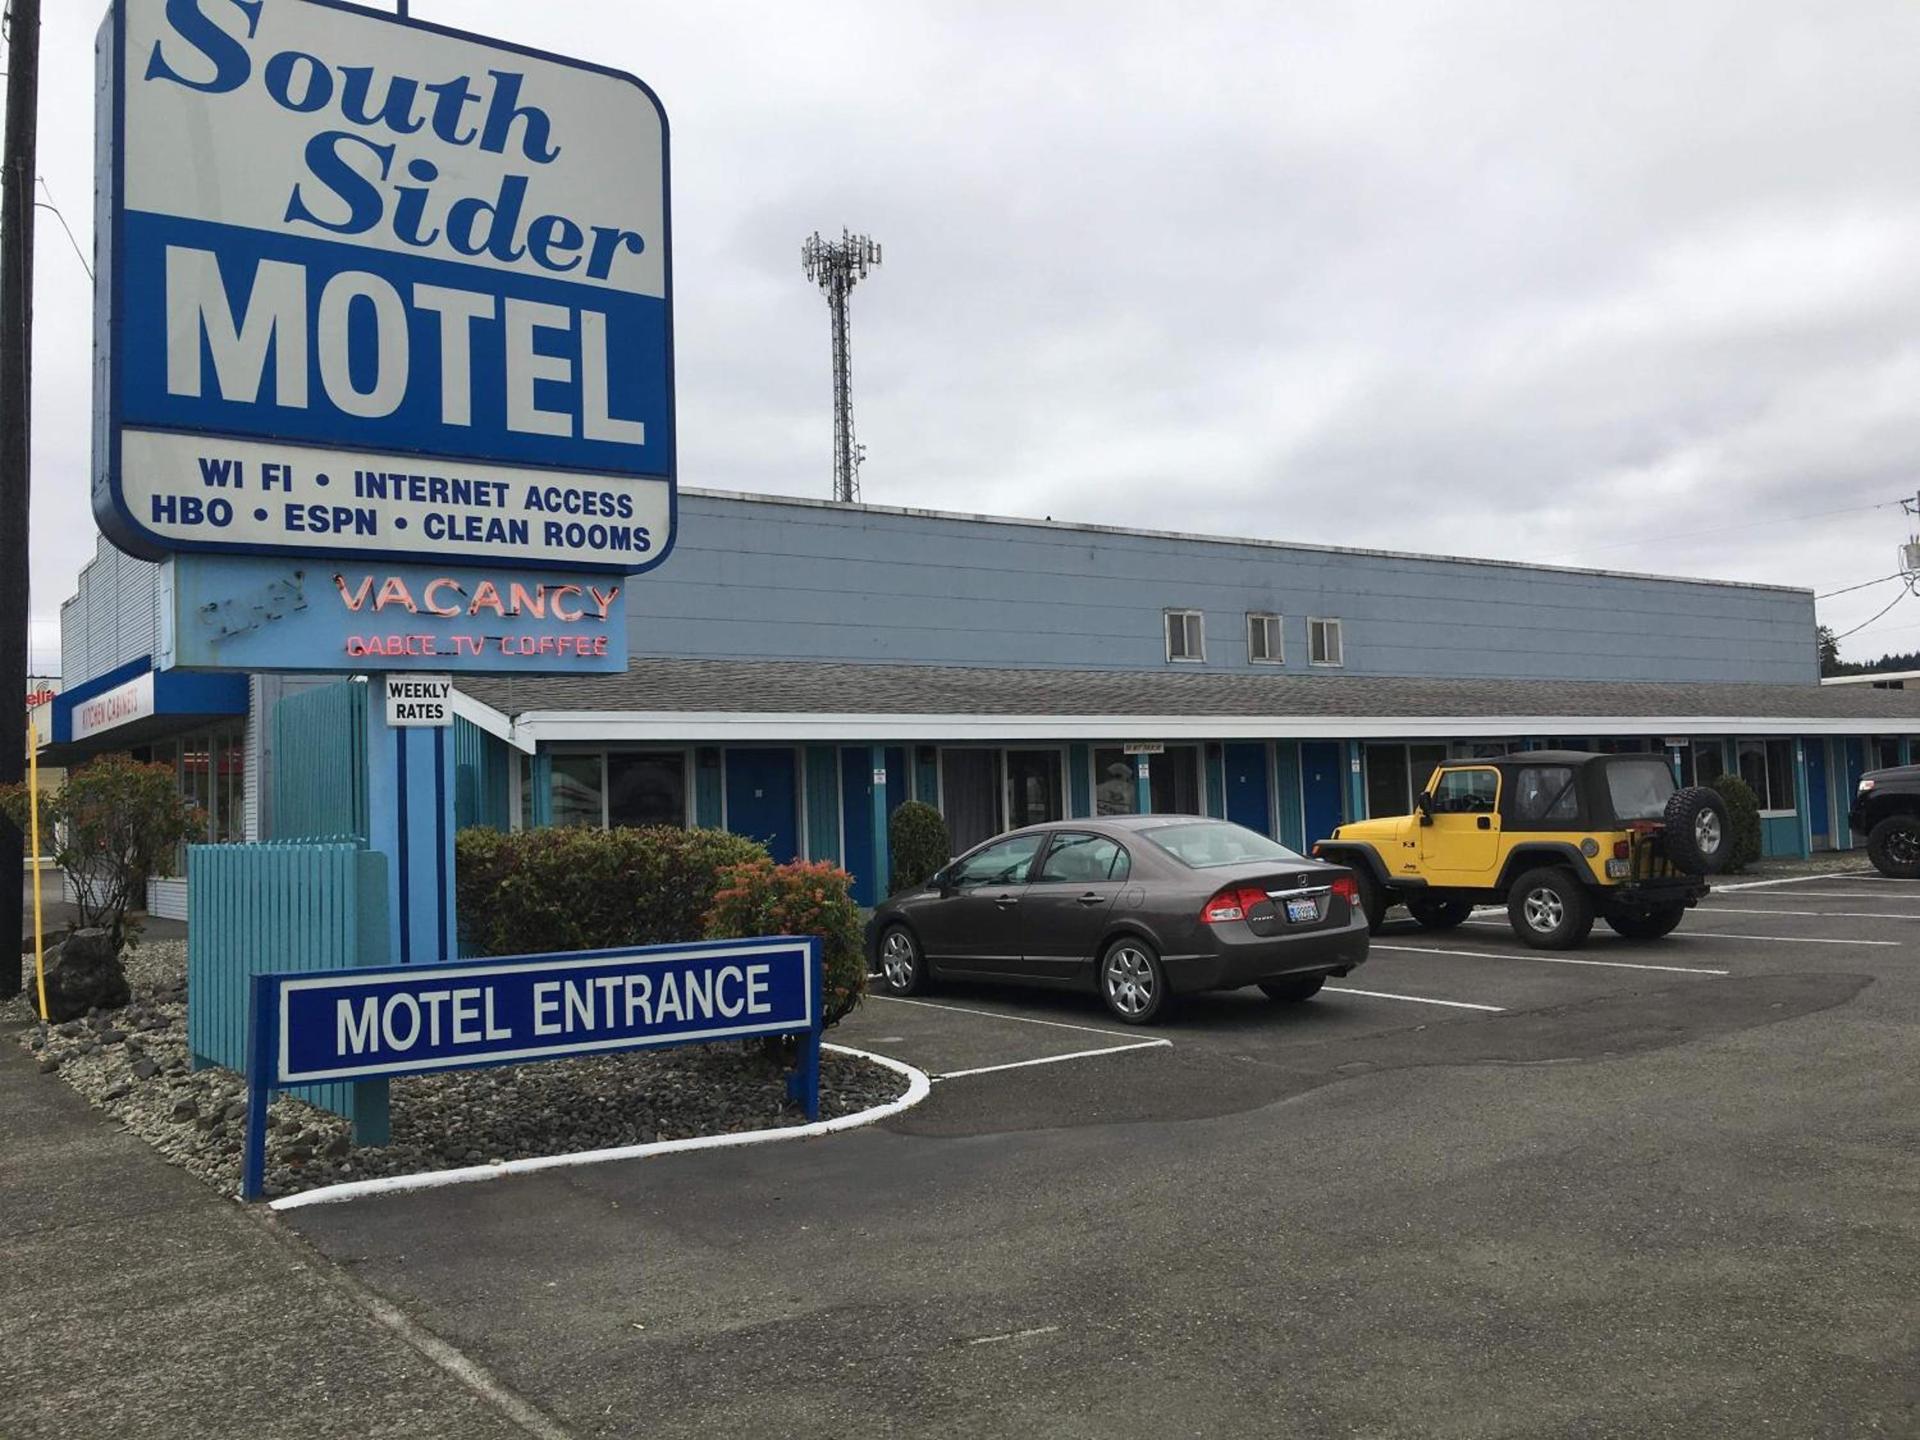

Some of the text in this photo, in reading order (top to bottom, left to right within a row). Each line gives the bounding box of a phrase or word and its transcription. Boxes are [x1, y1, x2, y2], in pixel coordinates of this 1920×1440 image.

[144, 0, 561, 164] South
[284, 130, 645, 281] Sider
[165, 244, 645, 445] MOTEL
[198, 457, 633, 519] WI FI INTERNET ACCESS
[151, 494, 650, 552] HBO ESPN CLEAN ROOMS
[333, 574, 619, 622] VACANCY
[450, 635, 485, 657] TV
[501, 635, 609, 657] COFFEE
[389, 682, 450, 698] WEEKLY
[396, 703, 444, 719] RATES
[336, 964, 772, 1057] MOTEL ENTRANCE
